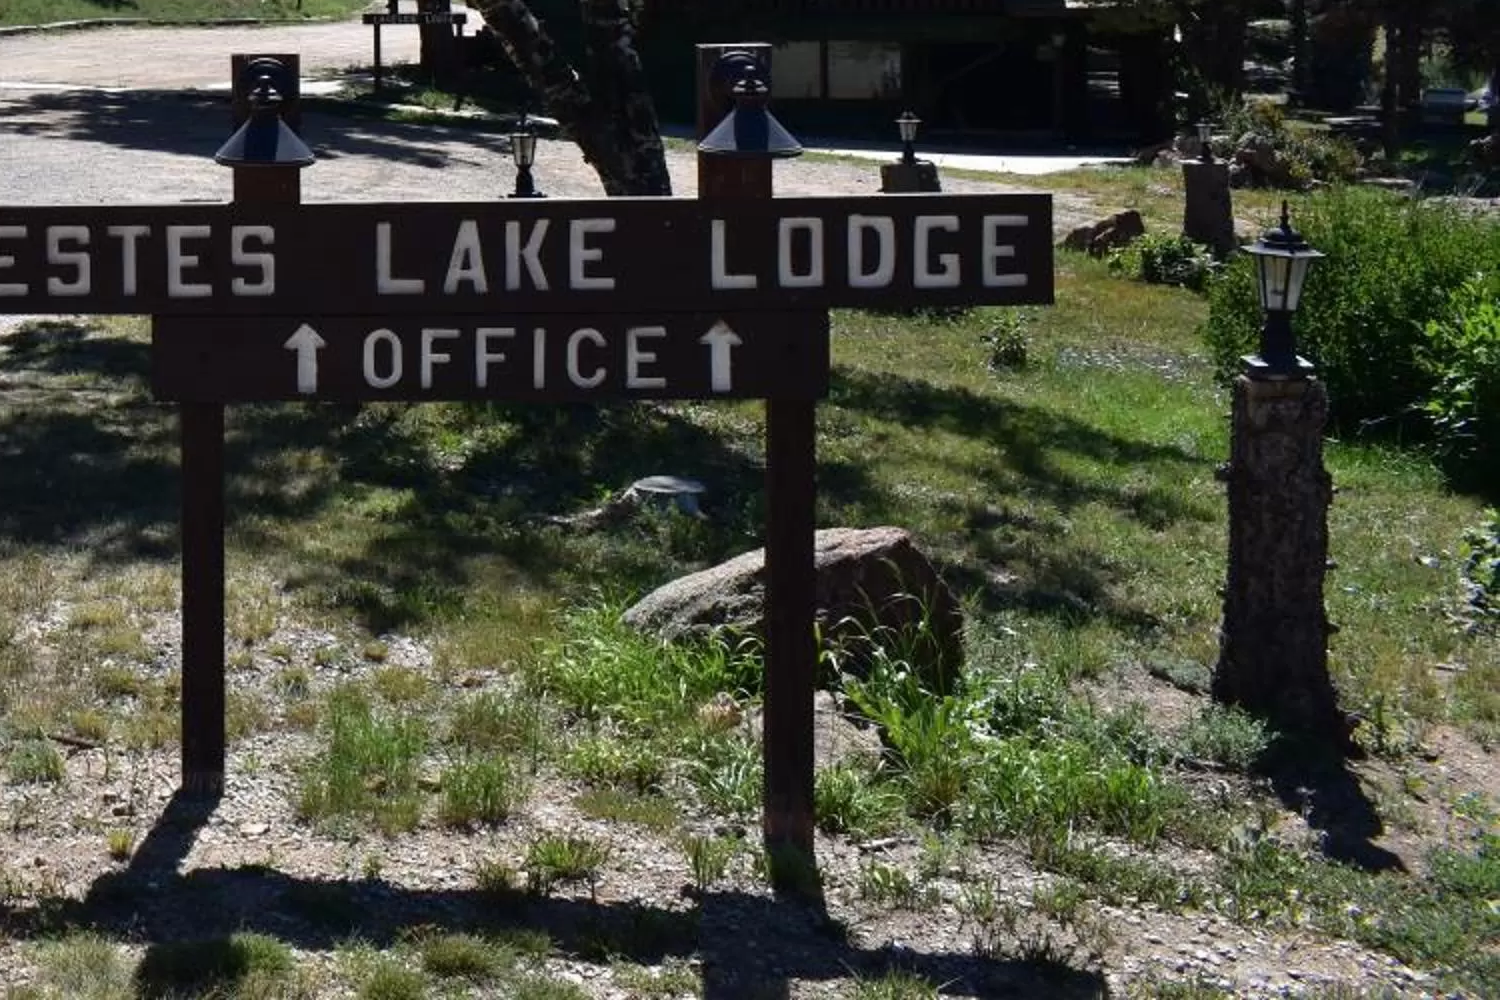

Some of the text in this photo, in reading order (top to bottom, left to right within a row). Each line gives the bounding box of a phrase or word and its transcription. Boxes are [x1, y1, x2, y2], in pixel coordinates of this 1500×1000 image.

[377, 218, 617, 293] LAKE
[710, 214, 1029, 290] LODGE
[362, 326, 667, 388] OFFICE
